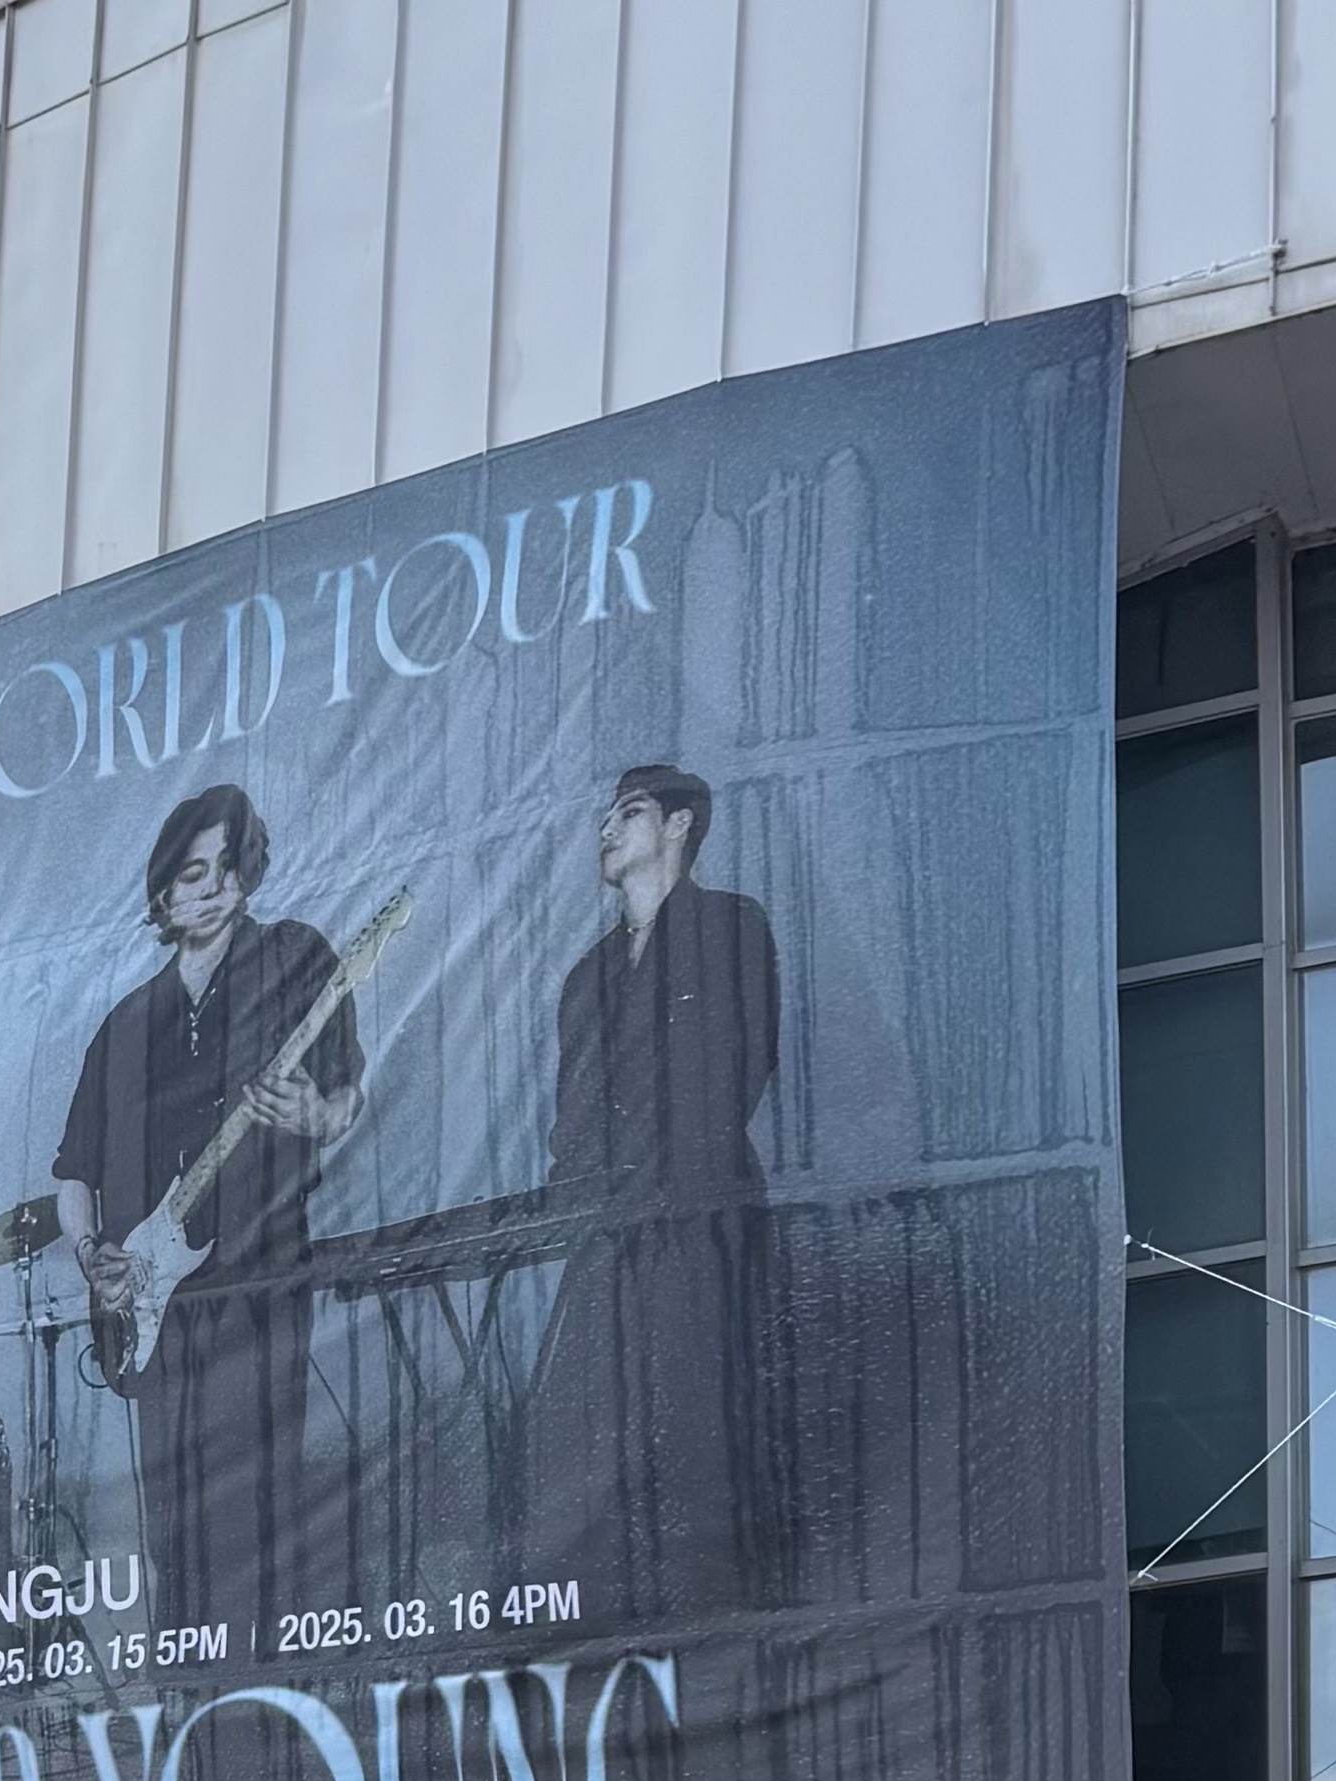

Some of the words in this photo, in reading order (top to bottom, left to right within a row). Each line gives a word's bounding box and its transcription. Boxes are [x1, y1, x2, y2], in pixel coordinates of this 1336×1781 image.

[314, 478, 654, 706] TOUR
[44, 1640, 92, 1680] 03.
[107, 1632, 145, 1671] 15
[156, 1622, 228, 1667] 5PM
[278, 1607, 371, 1652] 2025.
[384, 1599, 435, 1640] 03.
[449, 1590, 491, 1631] 16
[501, 1579, 581, 1627] 4PM
